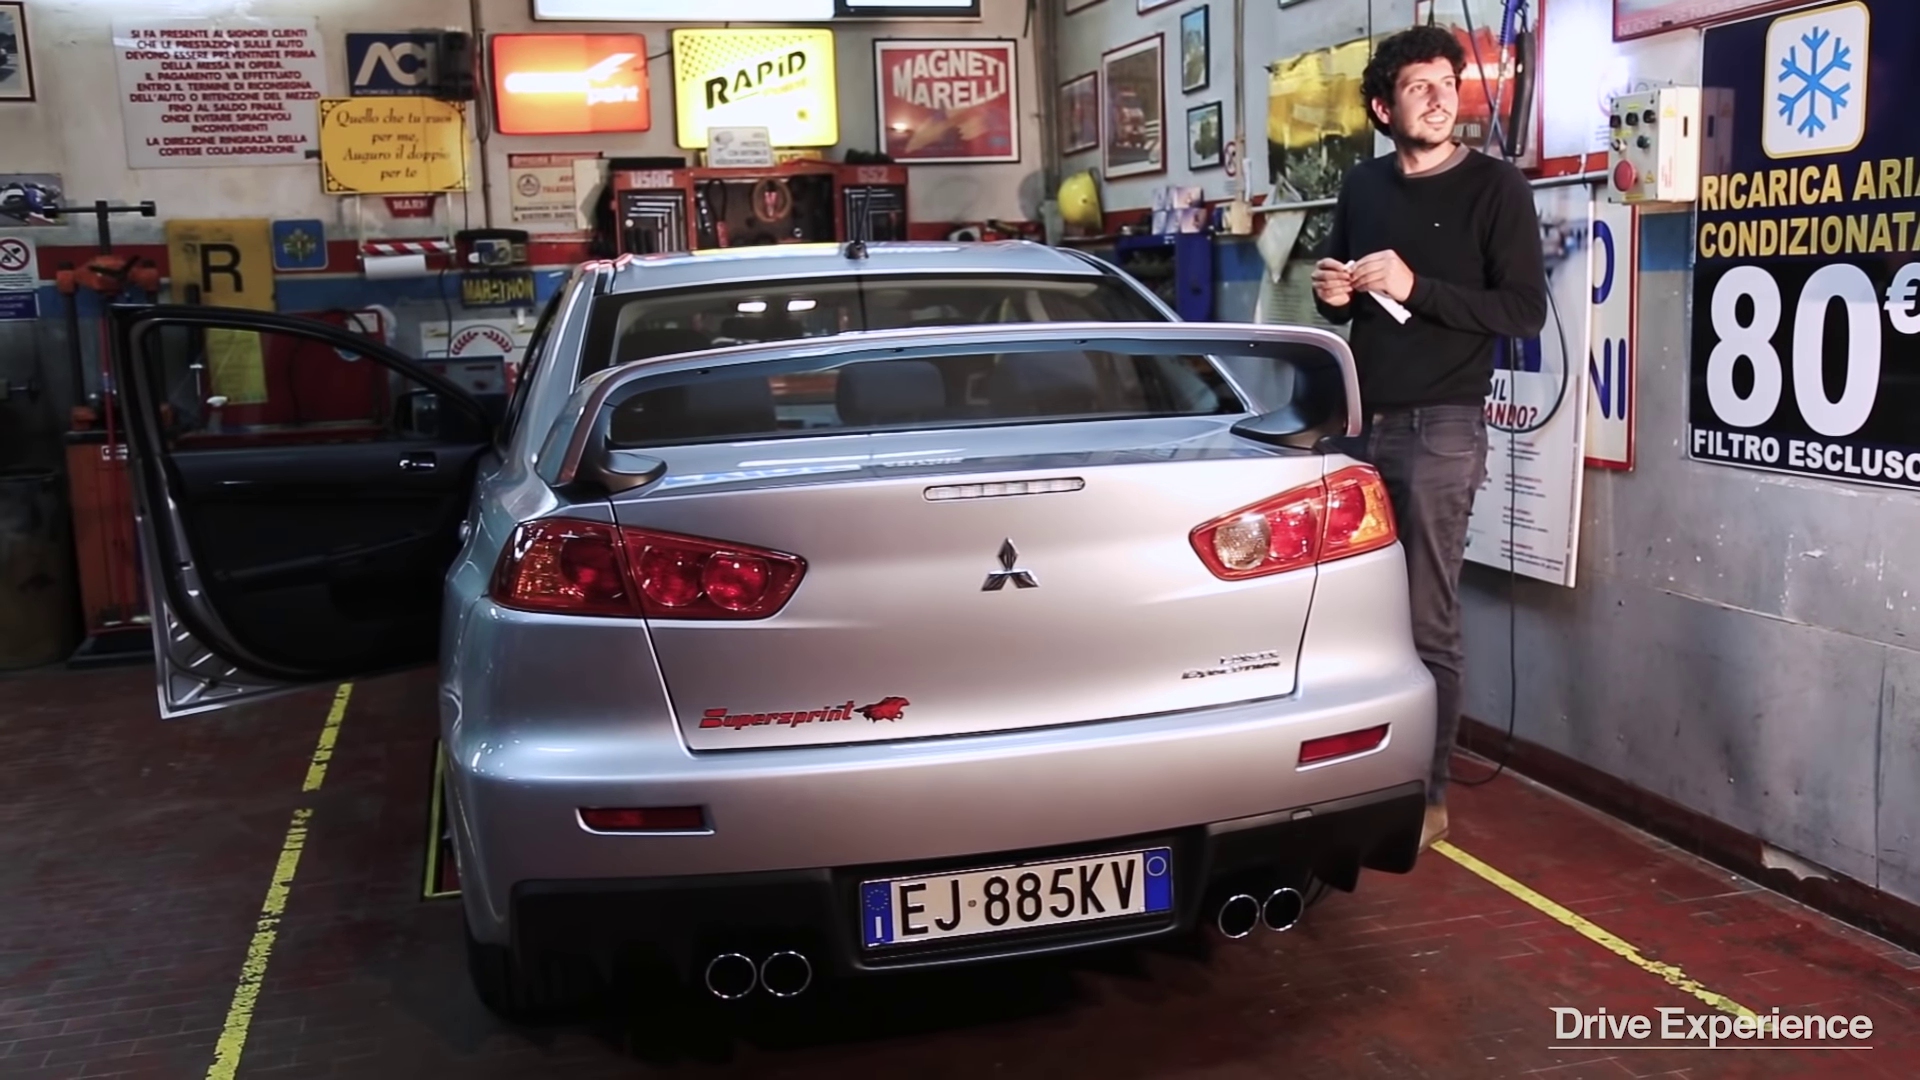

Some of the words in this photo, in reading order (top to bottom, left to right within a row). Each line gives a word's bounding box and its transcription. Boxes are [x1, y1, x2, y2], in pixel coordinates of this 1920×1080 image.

[131, 30, 140, 38] SI
[144, 30, 156, 38] FA
[160, 30, 208, 38] PRESENTE
[272, 29, 307, 37] CLIENTI
[137, 41, 156, 49] CHE
[176, 40, 239, 48] PRESTAZIONI
[243, 40, 272, 48] SULLE
[276, 40, 303, 48] AUTO
[125, 51, 170, 59] DEVONO
[174, 51, 208, 59] ESSERE
[213, 51, 280, 59] PREVENTIVATE
[285, 50, 316, 58] PRIMA
[162, 62, 192, 70] DELLA
[892, 49, 1006, 92] MAGNETI
[158, 72, 222, 80] PAGAMENTO
[227, 72, 239, 80] VA
[137, 83, 171, 91] ENTRO
[176, 83, 183, 91] IL
[188, 83, 229, 91] TERMINE
[234, 82, 244, 90] DI
[130, 94, 186, 102] DELL'AUTO
[202, 93, 259, 101] RITENZIONE
[263, 92, 281, 100] DEL
[169, 104, 192, 112] FINO
[161, 114, 190, 123] ONDE
[194, 114, 232, 122] EVITARE
[236, 113, 291, 121] SPIACEVOLI
[336, 108, 379, 127] Quello
[383, 108, 404, 123] che
[408, 113, 420, 123] tu
[192, 124, 268, 133] INCONVENIENTI
[146, 138, 160, 146] LA
[163, 137, 215, 145] DIREZIONE
[219, 136, 273, 144] RINGRAZIA
[277, 135, 307, 143] DELLA
[372, 134, 392, 145] per
[159, 148, 202, 156] CORTESE
[343, 148, 391, 164] Auguro
[396, 146, 403, 159] il
[407, 144, 449, 162] doppio
[380, 170, 401, 181] per
[405, 167, 417, 178] te
[1701, 164, 1843, 211] RICARICA
[201, 244, 243, 293] R
[1694, 428, 1779, 463] FILTRO
[699, 700, 855, 730] Supersprint
[899, 879, 962, 936] EJ
[983, 858, 1137, 927] 885KV
